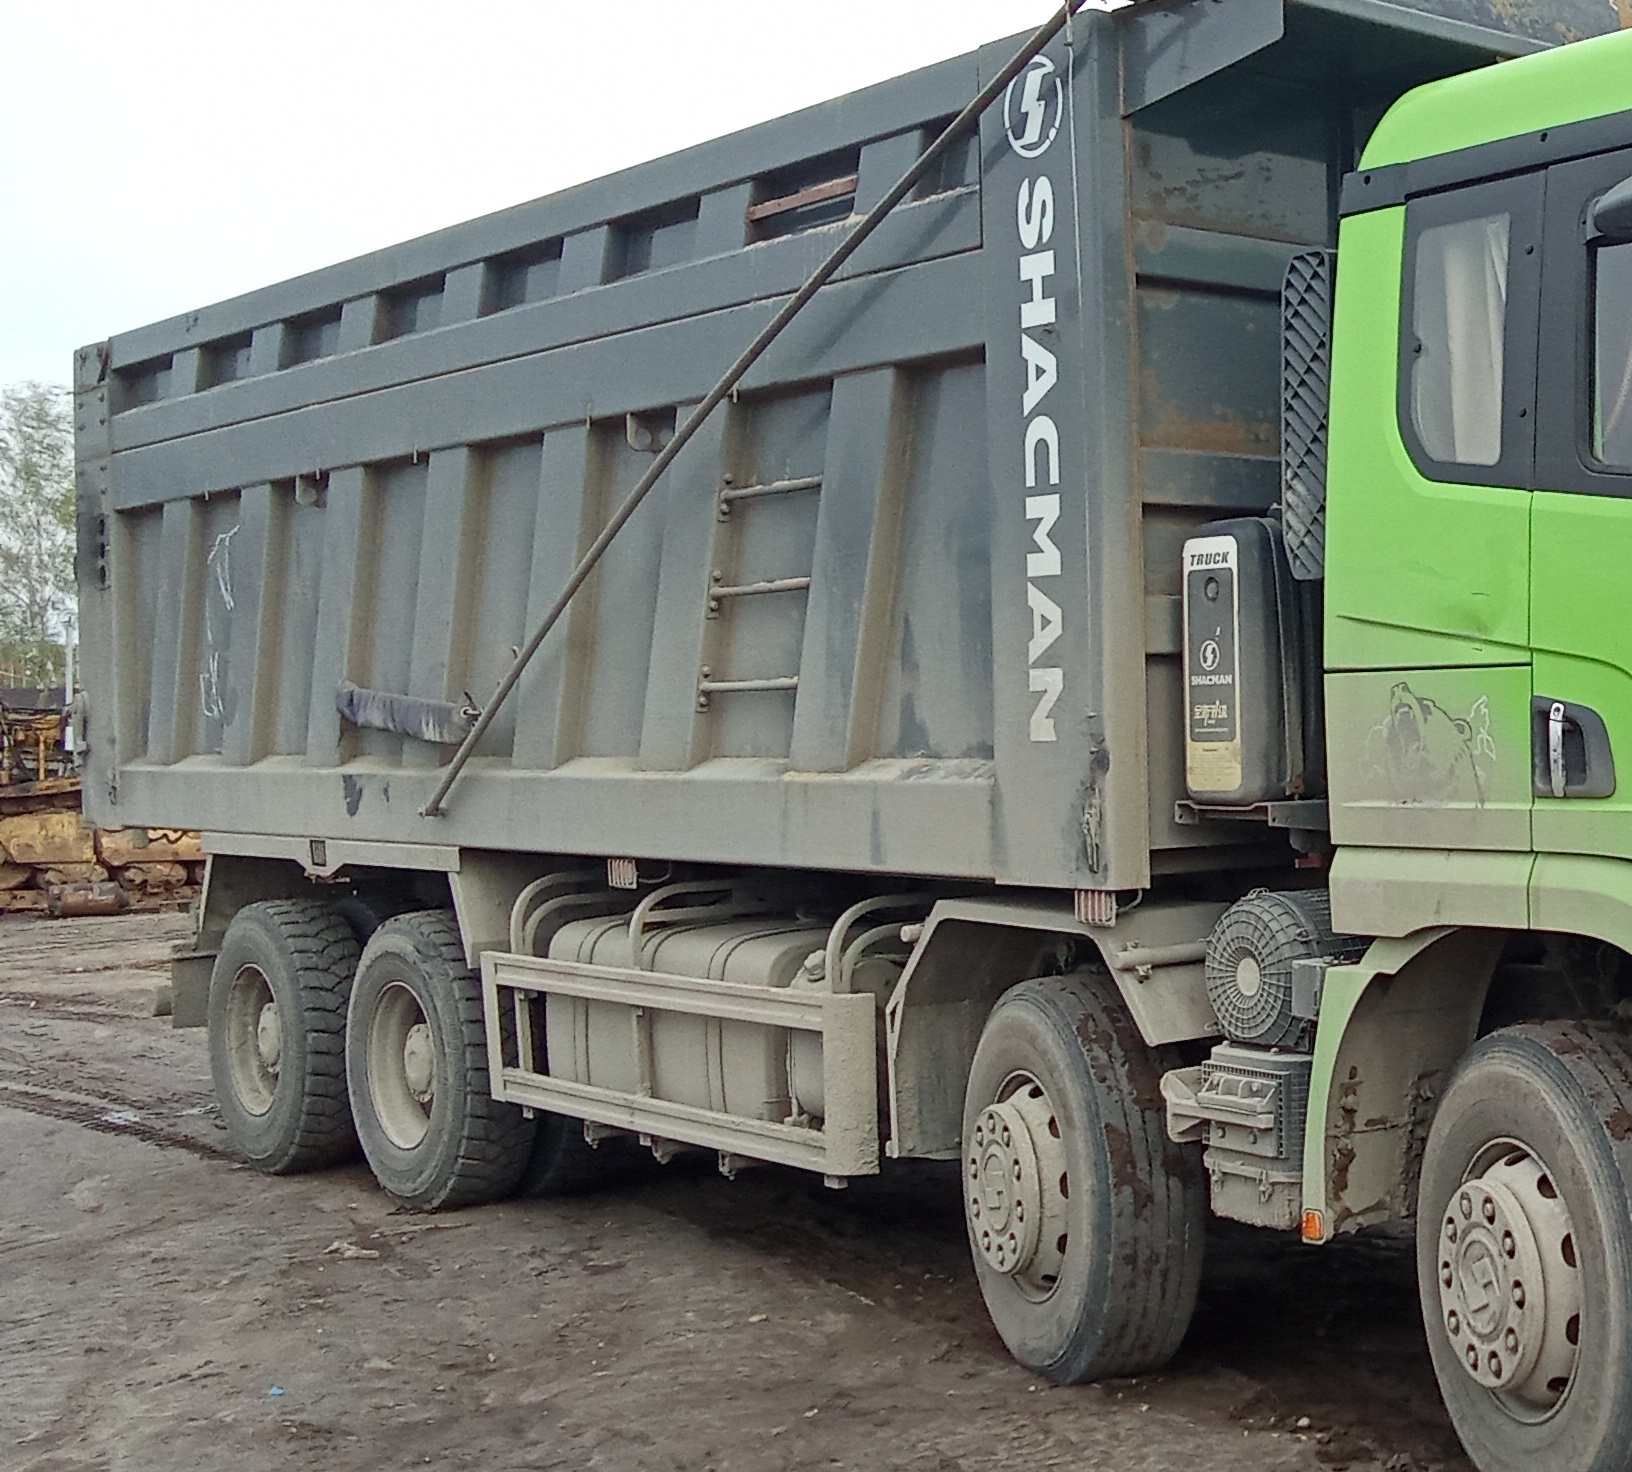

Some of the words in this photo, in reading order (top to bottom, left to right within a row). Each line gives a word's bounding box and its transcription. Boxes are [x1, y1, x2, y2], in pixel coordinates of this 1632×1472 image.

[1017, 175, 1064, 742] SHACMAN
[1190, 551, 1230, 566] TRUCK
[1191, 674, 1233, 686] SHACMAN
